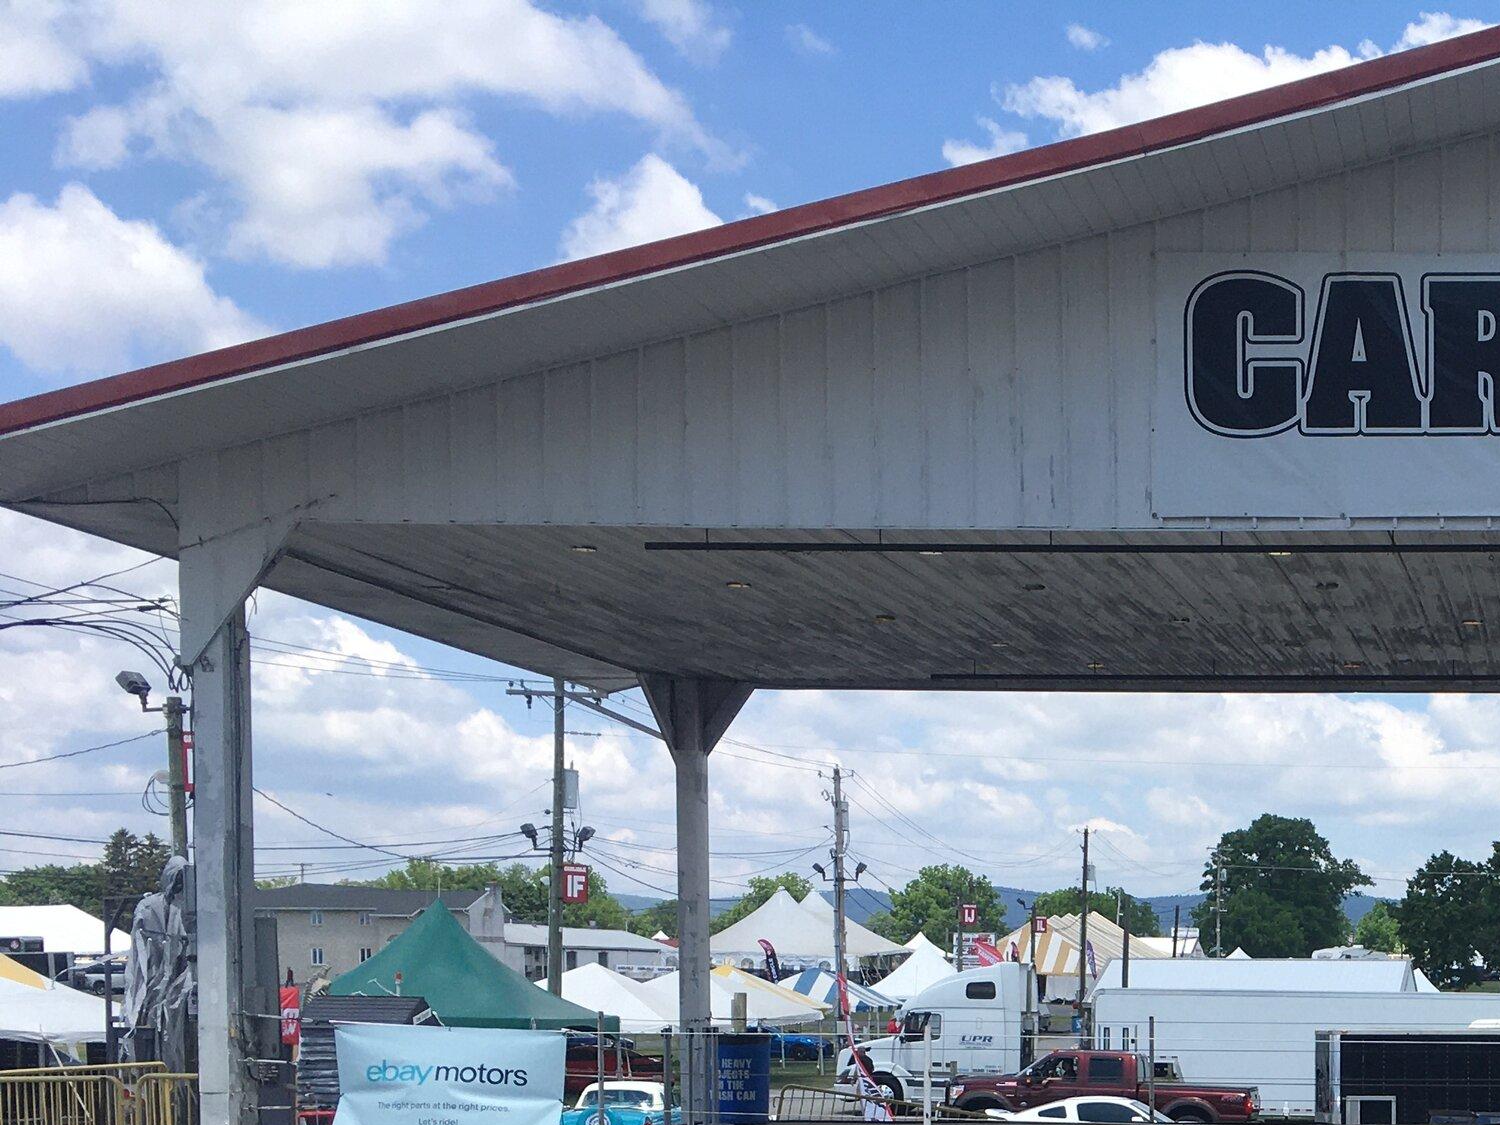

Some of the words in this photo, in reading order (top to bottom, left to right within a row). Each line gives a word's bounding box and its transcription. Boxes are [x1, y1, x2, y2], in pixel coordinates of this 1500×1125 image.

[567, 874, 586, 898] IF
[964, 908, 975, 923] IJ
[1036, 920, 1045, 932] IL
[961, 1035, 993, 1043] UPR
[721, 1058, 752, 1069] HEAVY
[366, 1059, 434, 1086] ebay
[435, 1063, 528, 1087] motors
[727, 1080, 744, 1090] THE
[736, 1090, 756, 1101] CAN
[378, 1101, 391, 1110] The
[392, 1101, 409, 1110] right
[411, 1102, 431, 1111] parts
[442, 1102, 457, 1110] the
[458, 1102, 479, 1112] right
[418, 1117, 438, 1125] Let's
[439, 1118, 459, 1125] ride!
